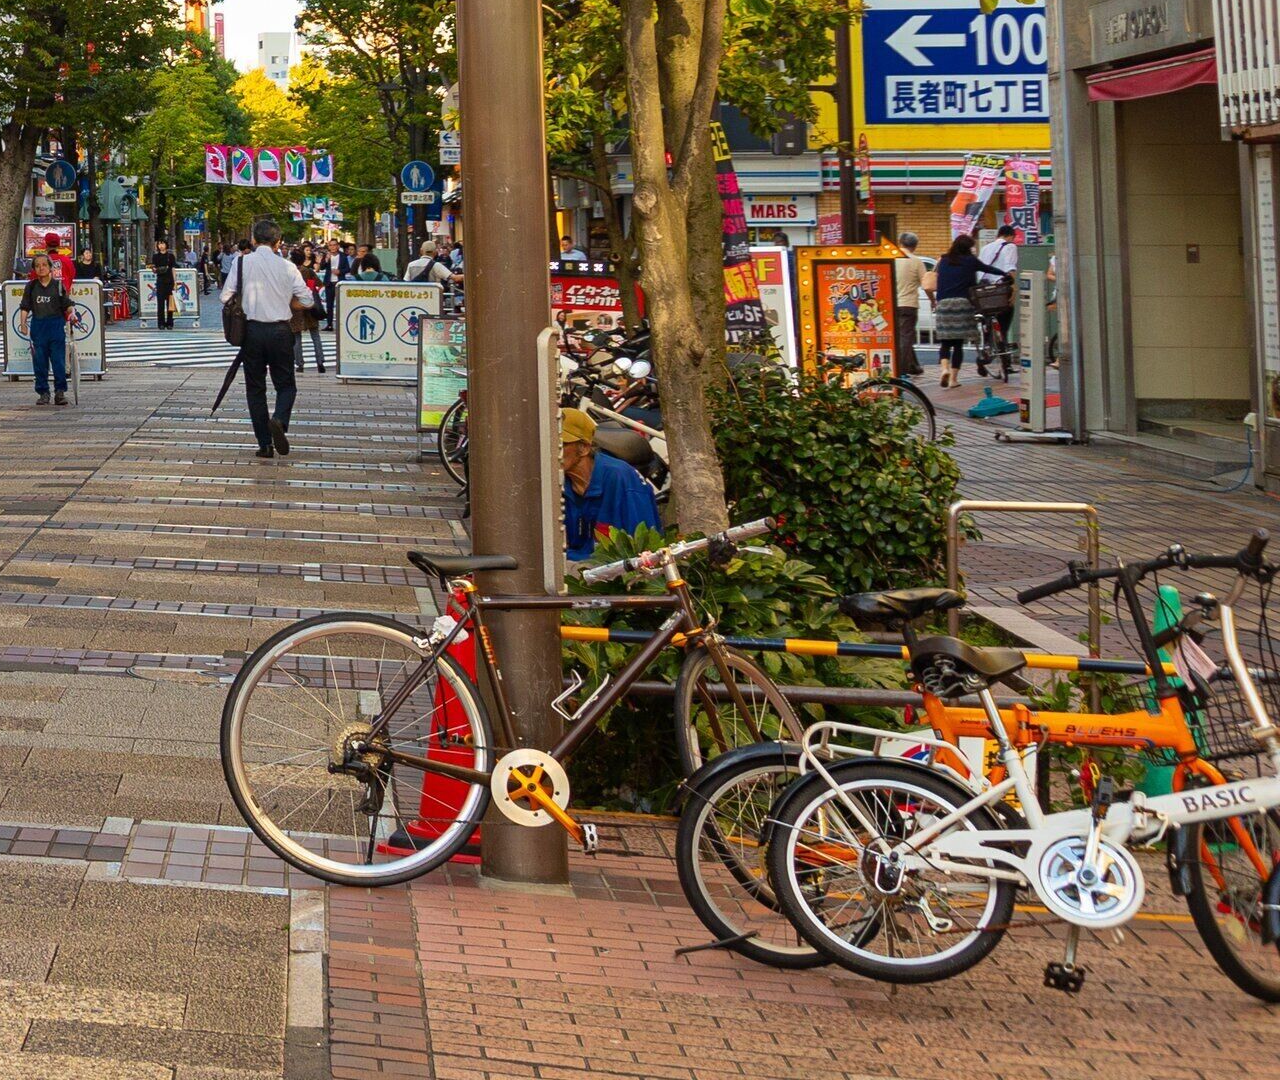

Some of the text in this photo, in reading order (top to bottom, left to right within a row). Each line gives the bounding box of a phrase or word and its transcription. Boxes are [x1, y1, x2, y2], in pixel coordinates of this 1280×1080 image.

[892, 79, 1044, 114] 長者町七丁目
[750, 204, 798, 218] MARS
[565, 284, 620, 297] インターネッ
[36, 295, 51, 304] CATS
[1182, 784, 1256, 814] BASIC
